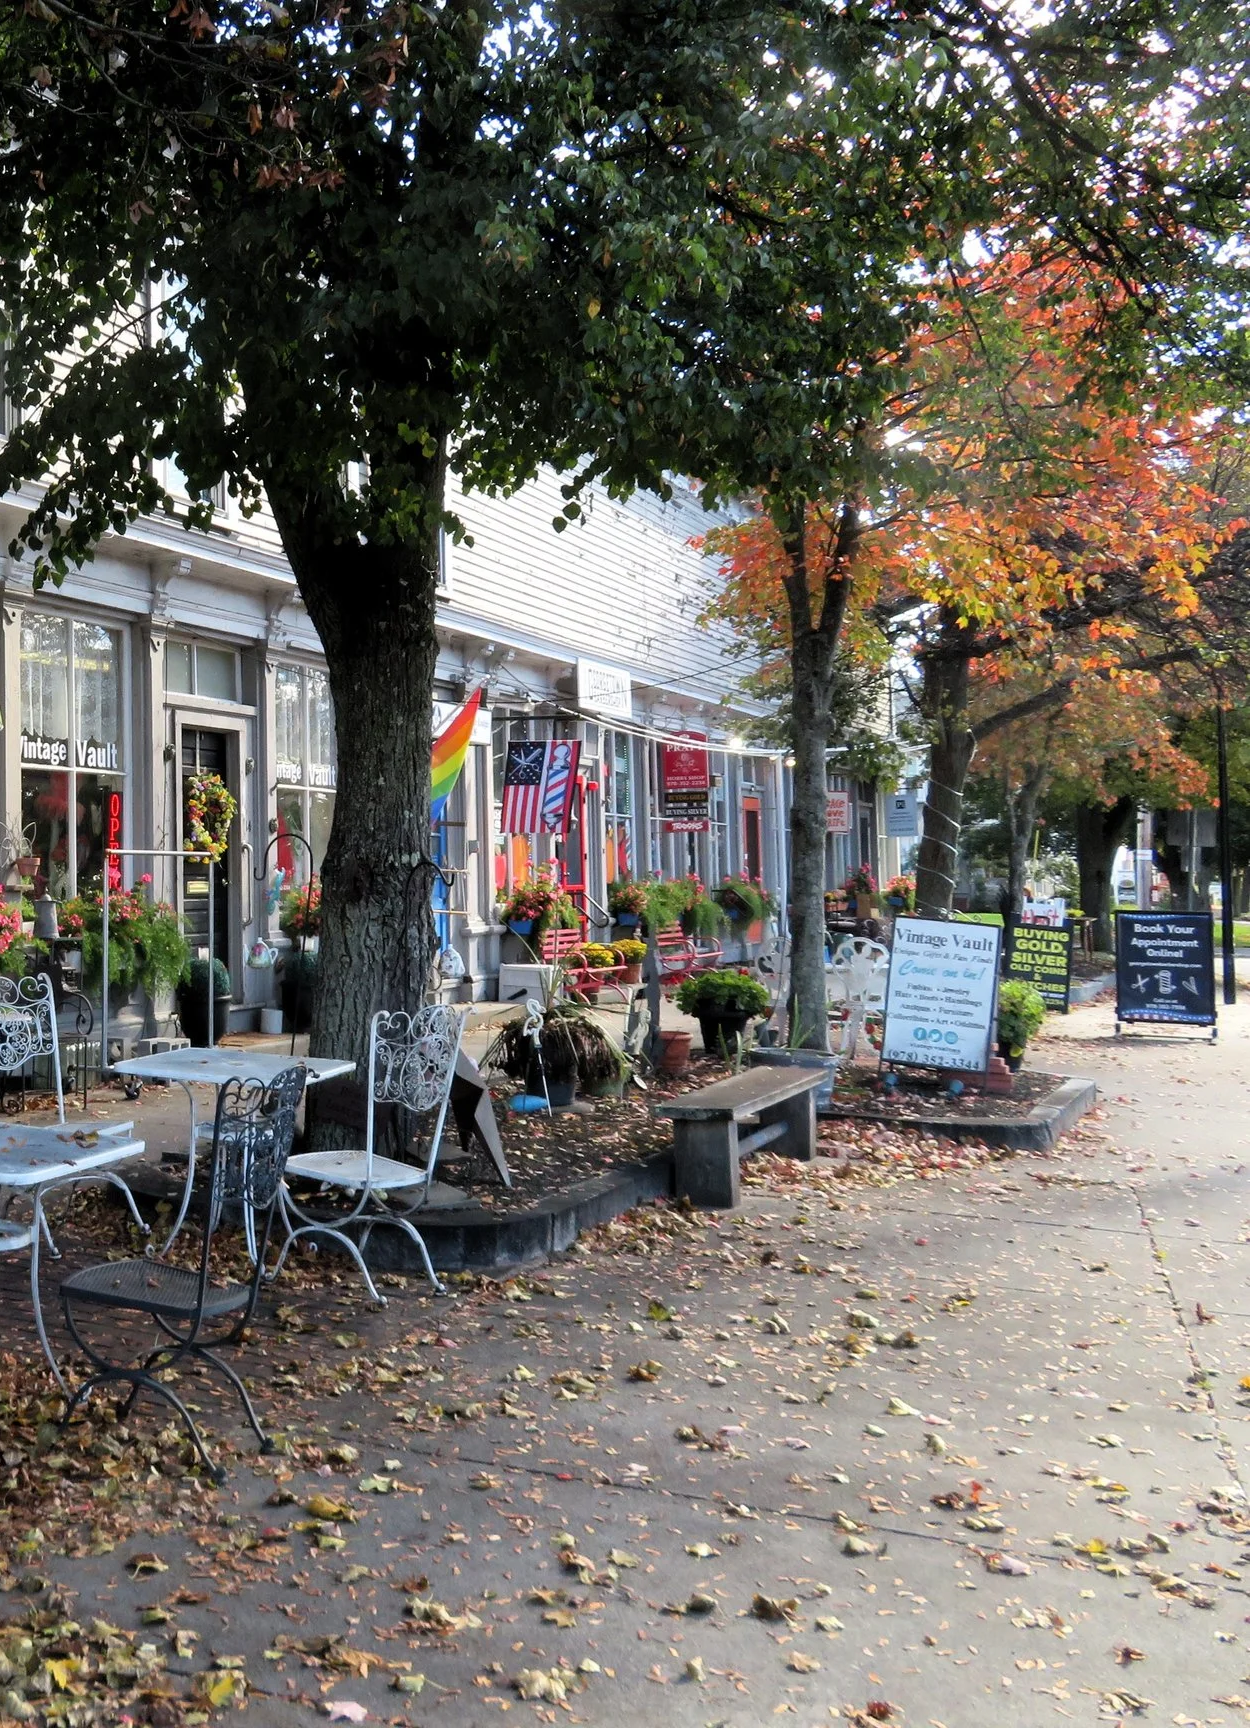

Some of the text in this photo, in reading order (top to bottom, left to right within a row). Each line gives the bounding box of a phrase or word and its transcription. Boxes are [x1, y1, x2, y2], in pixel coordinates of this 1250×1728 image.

[76, 739, 118, 769] Vault
[276, 763, 302, 783] ntage
[1013, 927, 1069, 942] BUYING
[1133, 923, 1195, 934] Book Your
[895, 928, 994, 951] Vintage Vault
[1131, 937, 1199, 948] Appointment
[1011, 951, 1068, 967] SILVER
[1146, 948, 1183, 958] Online!
[1010, 963, 1068, 976] OLD COINS
[1034, 973, 1042, 981] &
[1021, 980, 1067, 993] ATCHES
[888, 1049, 980, 1070] (978) 352-3344
